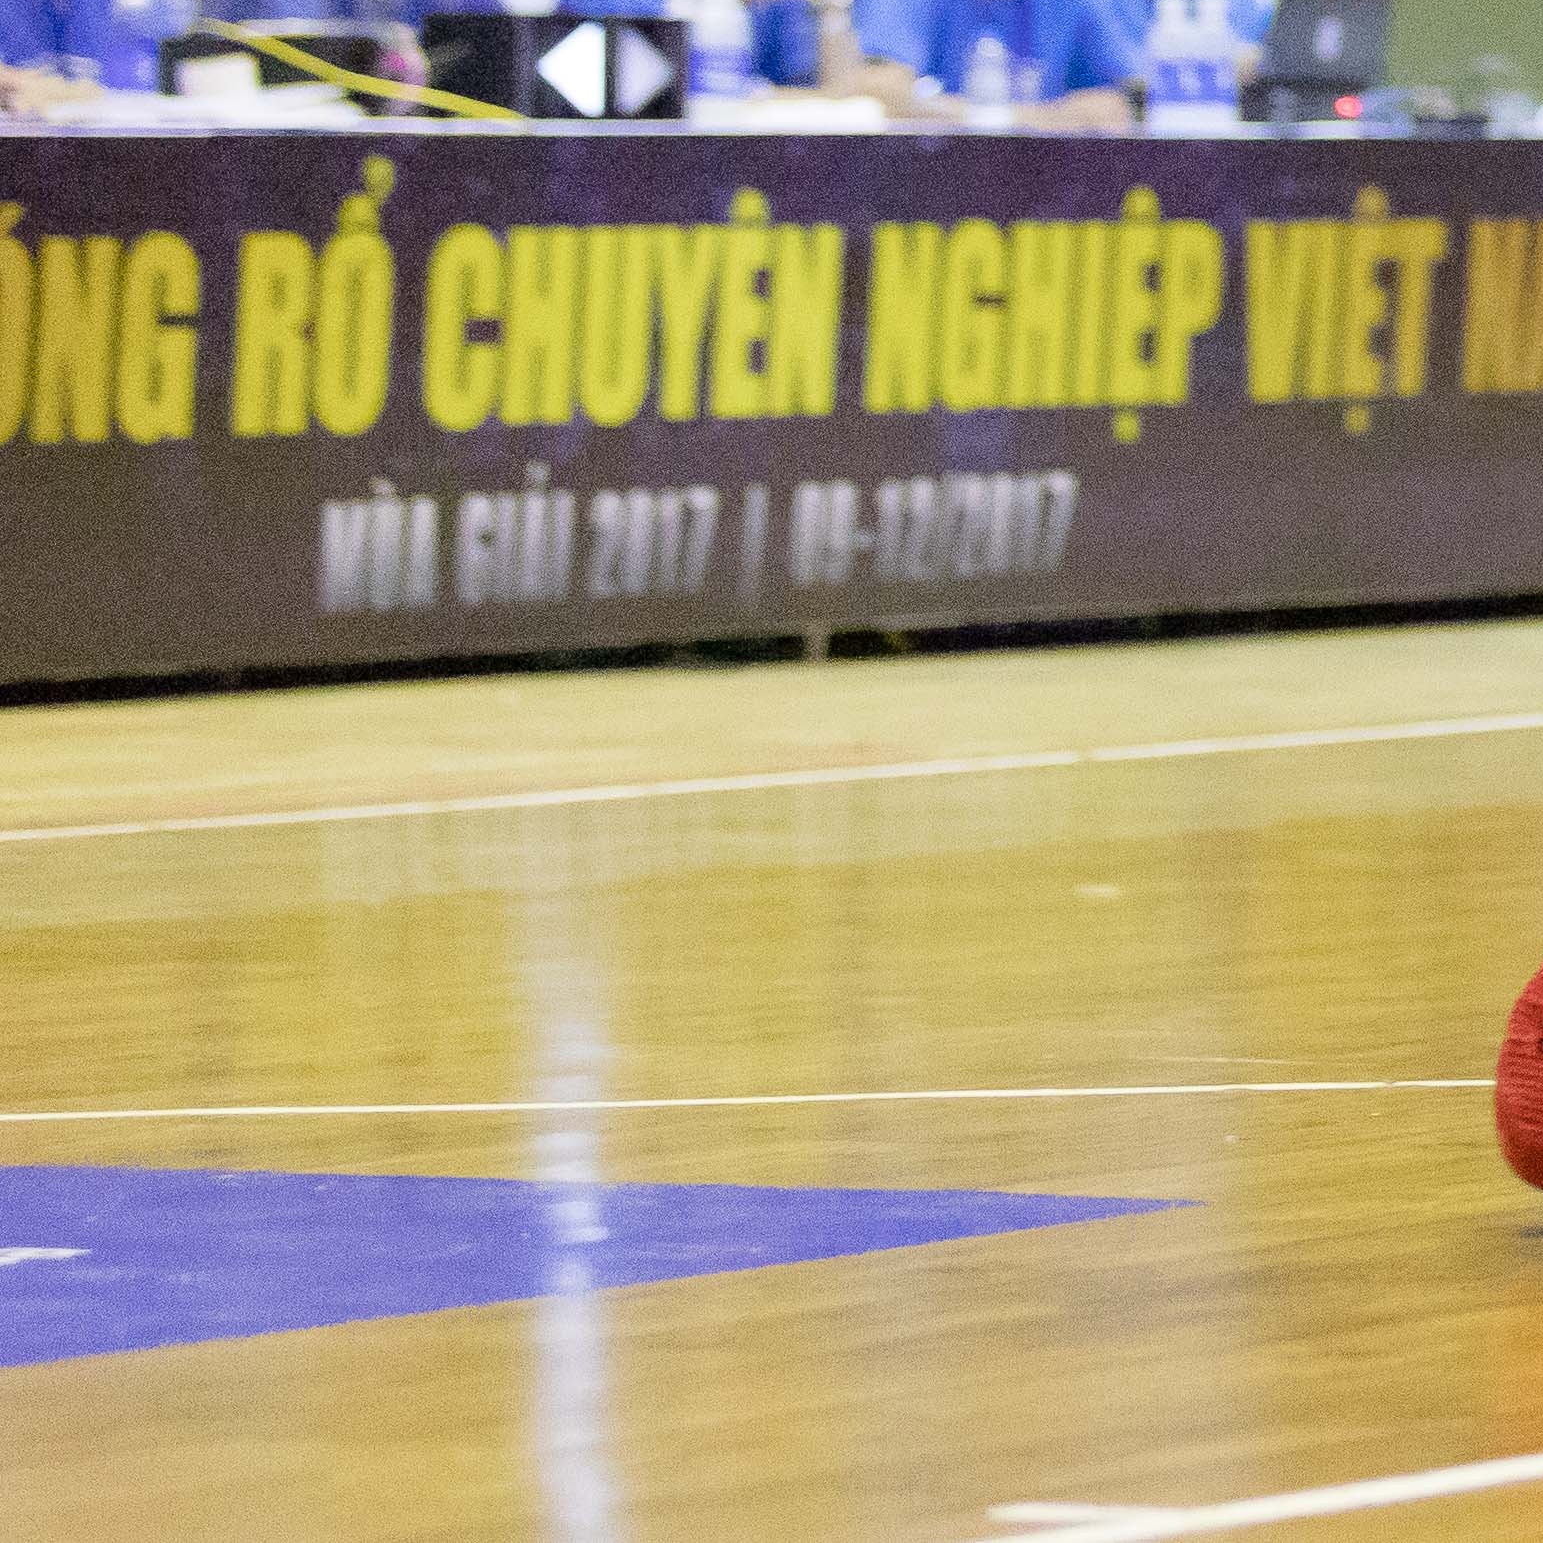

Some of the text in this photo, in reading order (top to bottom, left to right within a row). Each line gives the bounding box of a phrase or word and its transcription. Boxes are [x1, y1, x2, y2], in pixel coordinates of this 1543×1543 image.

[421, 187, 844, 432] CHUYÊN
[863, 184, 1225, 443] NGHIỆP
[1244, 184, 1449, 436] VIỆT
[587, 484, 721, 599] 2017
